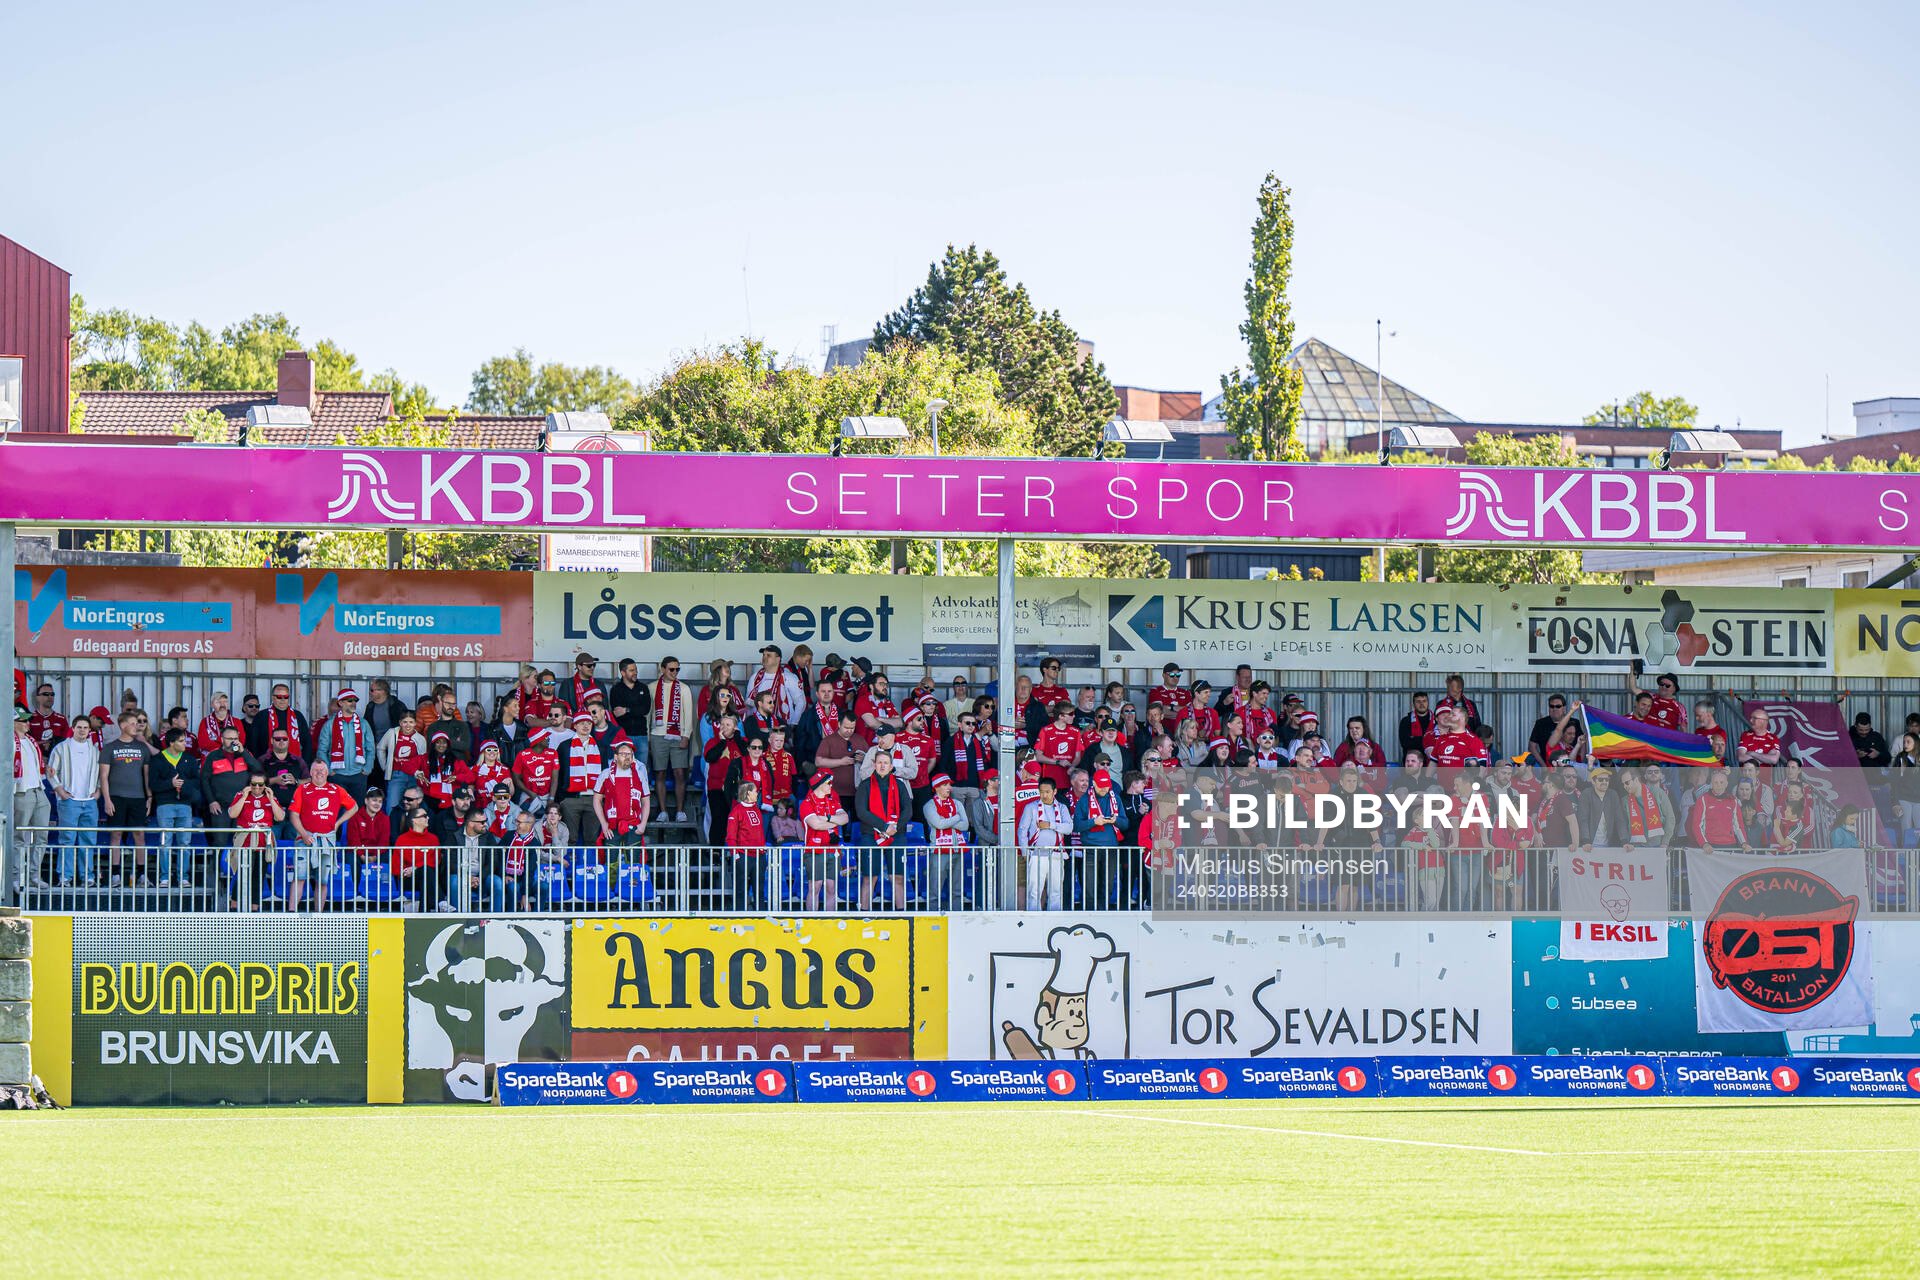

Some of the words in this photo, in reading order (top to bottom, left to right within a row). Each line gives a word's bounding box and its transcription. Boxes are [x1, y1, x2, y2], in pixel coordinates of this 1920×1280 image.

[421, 454, 646, 524] KBBL
[786, 471, 1055, 517] SETTER
[1106, 476, 1294, 522] SPOR
[1534, 473, 1746, 541] KBBL
[1878, 489, 1909, 531] S
[556, 548, 640, 558] SAMARBEIDSPARTNERE
[932, 595, 1029, 608] Advokathet
[72, 607, 165, 626] NorEngros
[344, 611, 435, 630] NorEngros
[563, 587, 894, 642] Låssenteret
[931, 610, 1029, 619] KRISTIANSND
[1175, 595, 1311, 631] KRUSE
[1327, 597, 1484, 634] LARSEN
[1528, 616, 1640, 655] FOSNA
[1711, 618, 1826, 657] STEIN
[72, 638, 140, 656] Ødegaard
[143, 639, 191, 656] Engros
[193, 639, 214, 653] AS
[344, 641, 410, 658] Ødegaard
[413, 642, 460, 659] Engros
[463, 643, 483, 657] AS
[1183, 640, 1252, 652] STRATEGI
[1352, 642, 1485, 655] KOMMUNIKASJON
[1572, 857, 1653, 881] STRIL
[1738, 877, 1816, 901] BRANN
[1575, 922, 1582, 940] I
[1590, 923, 1658, 943] EKSIL
[1771, 973, 1797, 983] 2011
[1741, 973, 1829, 1004] BATALJON
[1571, 996, 1637, 1010] Subsea
[101, 1030, 340, 1065] BRUNSVIKA
[505, 1071, 604, 1090] SpareBank
[615, 1075, 628, 1093] 1
[653, 1070, 752, 1089] SpareBank
[763, 1073, 776, 1091] 1
[809, 1071, 904, 1088] SpareBank
[914, 1074, 927, 1092] 1
[950, 1070, 1045, 1087] SpareBank
[1054, 1073, 1067, 1091] 1
[1103, 1069, 1197, 1086] SpareBank
[1206, 1072, 1218, 1089] 1
[1242, 1067, 1335, 1085] SpareBank
[1345, 1070, 1357, 1087] 1
[1391, 1065, 1486, 1082] SpareBank
[1495, 1069, 1508, 1086] 1
[1428, 1081, 1488, 1090] NORDMØRE
[1531, 1065, 1625, 1082] SpareBank
[1634, 1068, 1647, 1086] 1
[1568, 1081, 1627, 1090] NORDMØRE
[1676, 1066, 1769, 1083] SpareBank
[1778, 1070, 1791, 1087] 1
[1813, 1067, 1905, 1084] SpareBank
[544, 1089, 607, 1097] NORDMØRE
[692, 1088, 755, 1096] NORDMØRE
[847, 1088, 906, 1096] NORDMØRE
[1140, 1085, 1199, 1093] NORDMØRE
[1279, 1084, 1337, 1092] NORDMØRE
[1713, 1083, 1772, 1092] NORDMØRE
[1850, 1084, 1908, 1092] NORDMØRE
